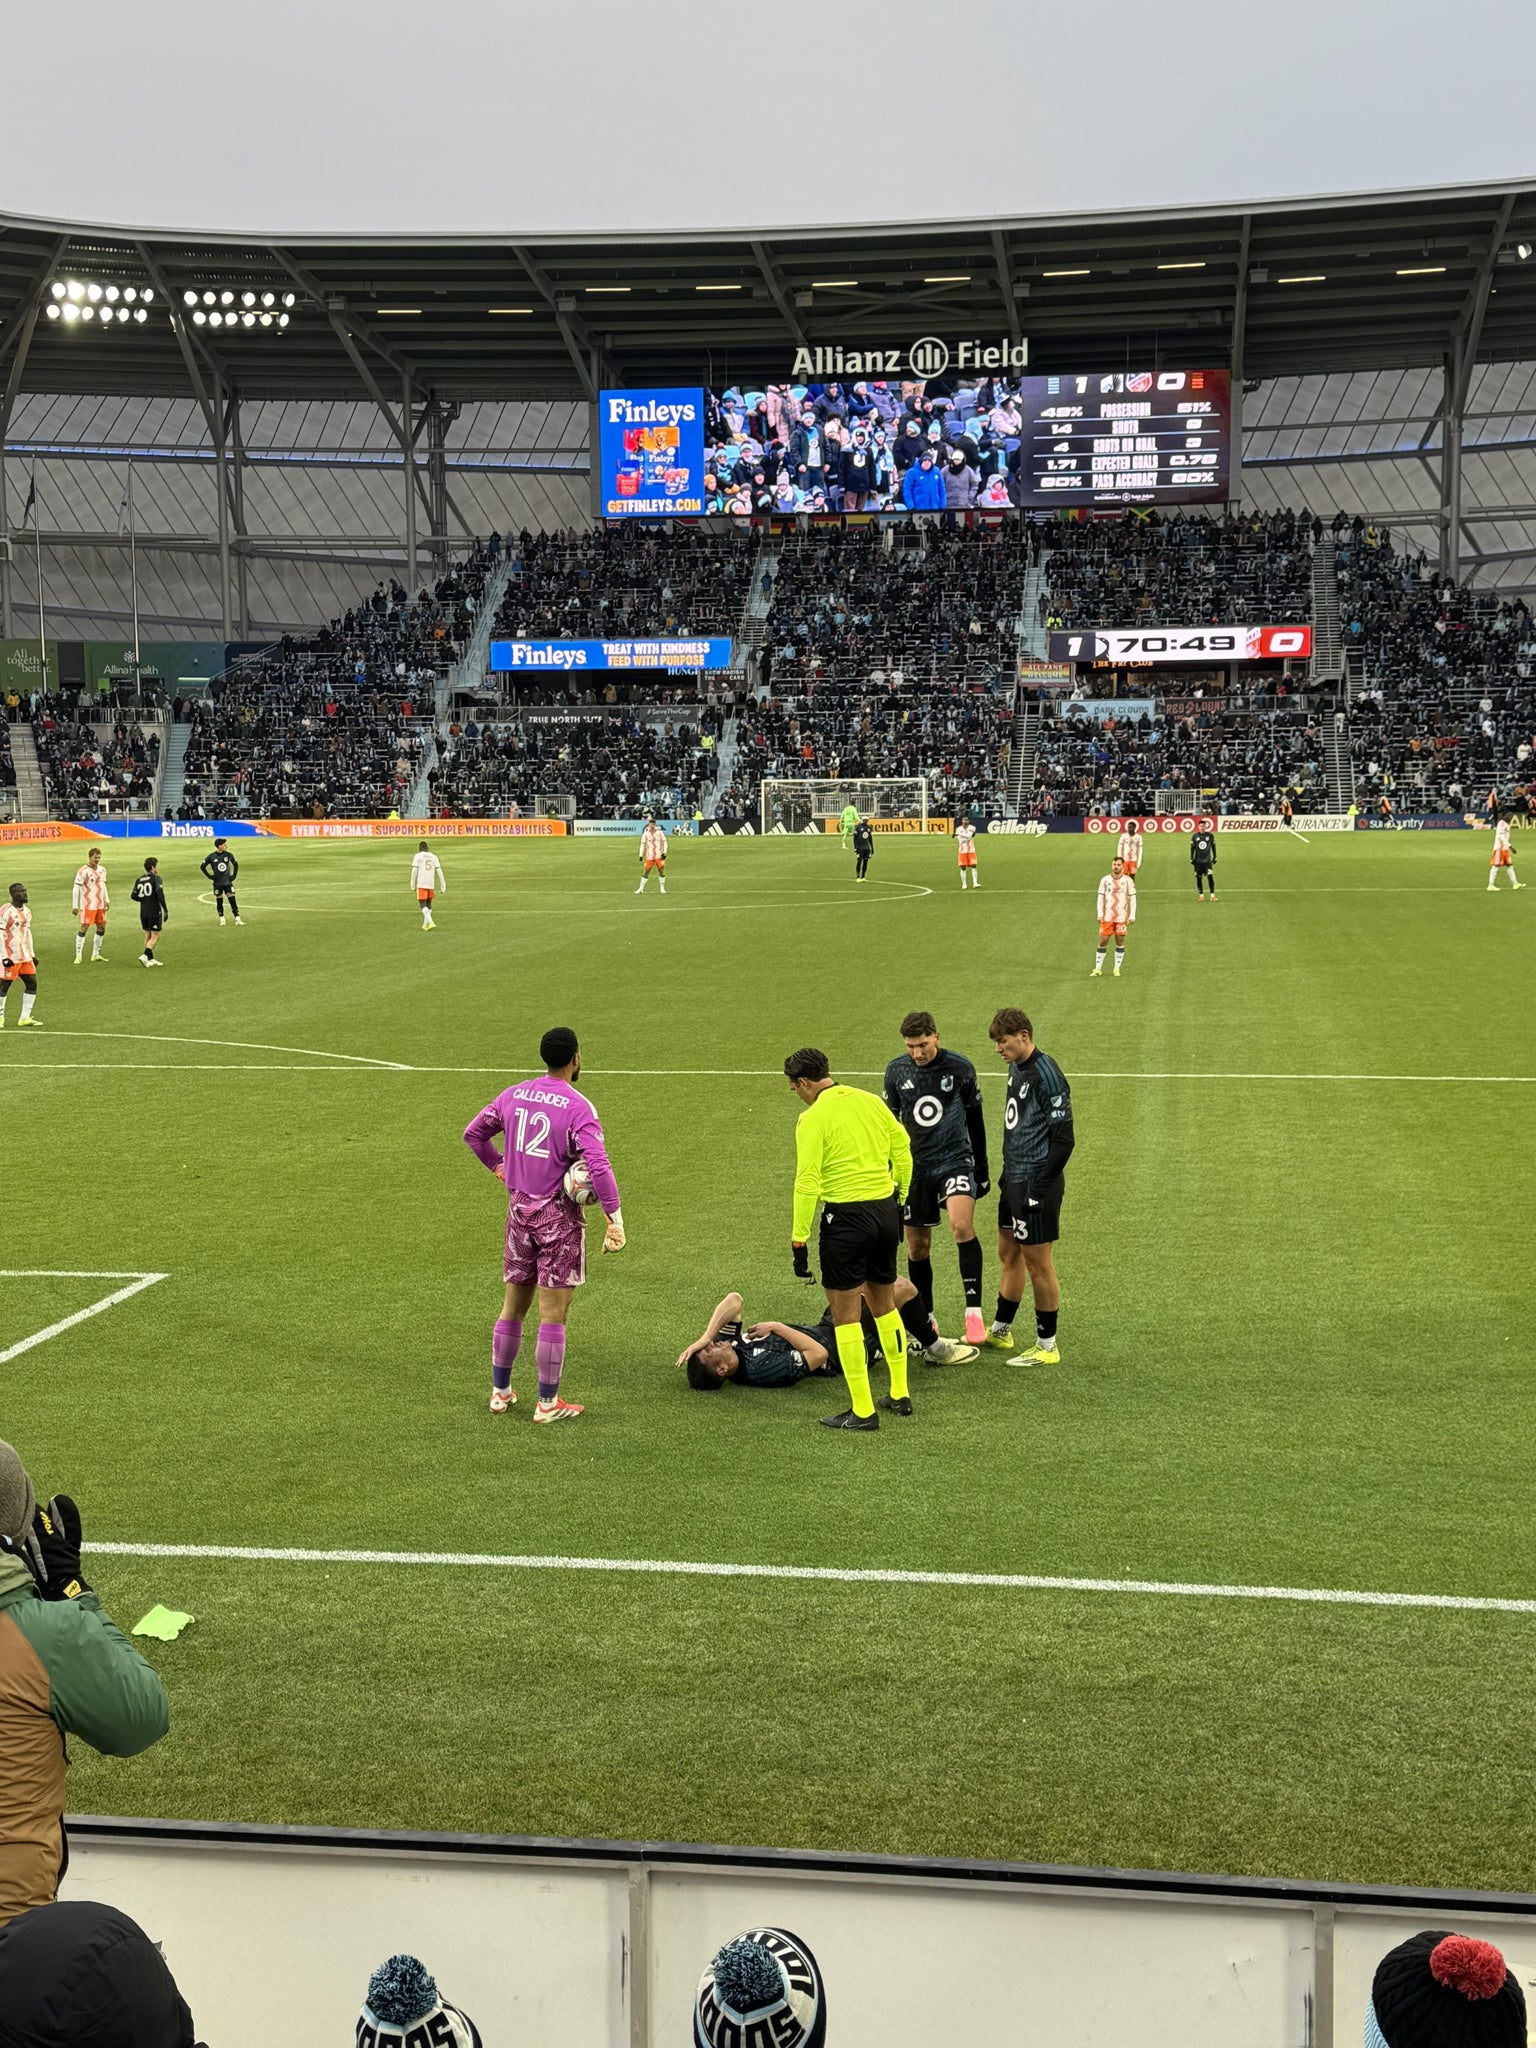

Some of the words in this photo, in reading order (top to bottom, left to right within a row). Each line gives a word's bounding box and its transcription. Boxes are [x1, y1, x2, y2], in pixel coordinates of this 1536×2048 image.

[791, 346, 901, 375] Allianz
[958, 337, 1029, 369] Field
[1075, 376, 1088, 394] 1
[1157, 372, 1186, 391] 0
[608, 399, 696, 426] Finleys
[1100, 402, 1151, 418] POSSESSION
[1051, 424, 1073, 435] 14
[1112, 420, 1139, 435] SHOTS
[1053, 442, 1070, 452] 4
[1093, 438, 1120, 453] SHOTS
[1136, 437, 1158, 451] GOAL
[1047, 459, 1077, 470] 1.71
[1092, 456, 1130, 471] EXPECTED
[1132, 455, 1158, 470] GOALS
[1092, 474, 1114, 488] PASS
[1115, 473, 1158, 487] ACCURACY
[607, 499, 701, 513] GETFINLEYS.COM
[602, 643, 632, 655] TREAT
[634, 643, 659, 654] WITH
[661, 642, 710, 654] KINDNESS
[1067, 636, 1083, 657] 1
[1117, 635, 1236, 654] 70:49
[1270, 632, 1304, 652] 0
[13, 649, 28, 658] All
[511, 643, 587, 669] Finleys
[608, 655, 631, 666] FEED
[633, 655, 658, 666] WITH
[660, 655, 704, 666] PURPOSE
[103, 665, 129, 675] Allina
[551, 715, 580, 723] NORTH
[161, 822, 214, 838] Finleys
[291, 824, 321, 836] EVERY
[323, 824, 373, 836] PURCHASE
[375, 824, 426, 836] SUPPORTS
[429, 824, 463, 835] PEOPLE
[465, 824, 489, 835] WITH
[492, 824, 553, 835] DISABILITIES
[987, 820, 1048, 837] Gillette
[1221, 820, 1278, 830] FEDERATED
[1279, 819, 1340, 830] ISURANCE
[137, 882, 152, 898] 20
[513, 1088, 570, 1109] CALLENDER
[515, 1107, 551, 1159] 12
[945, 1175, 971, 1195] 25
